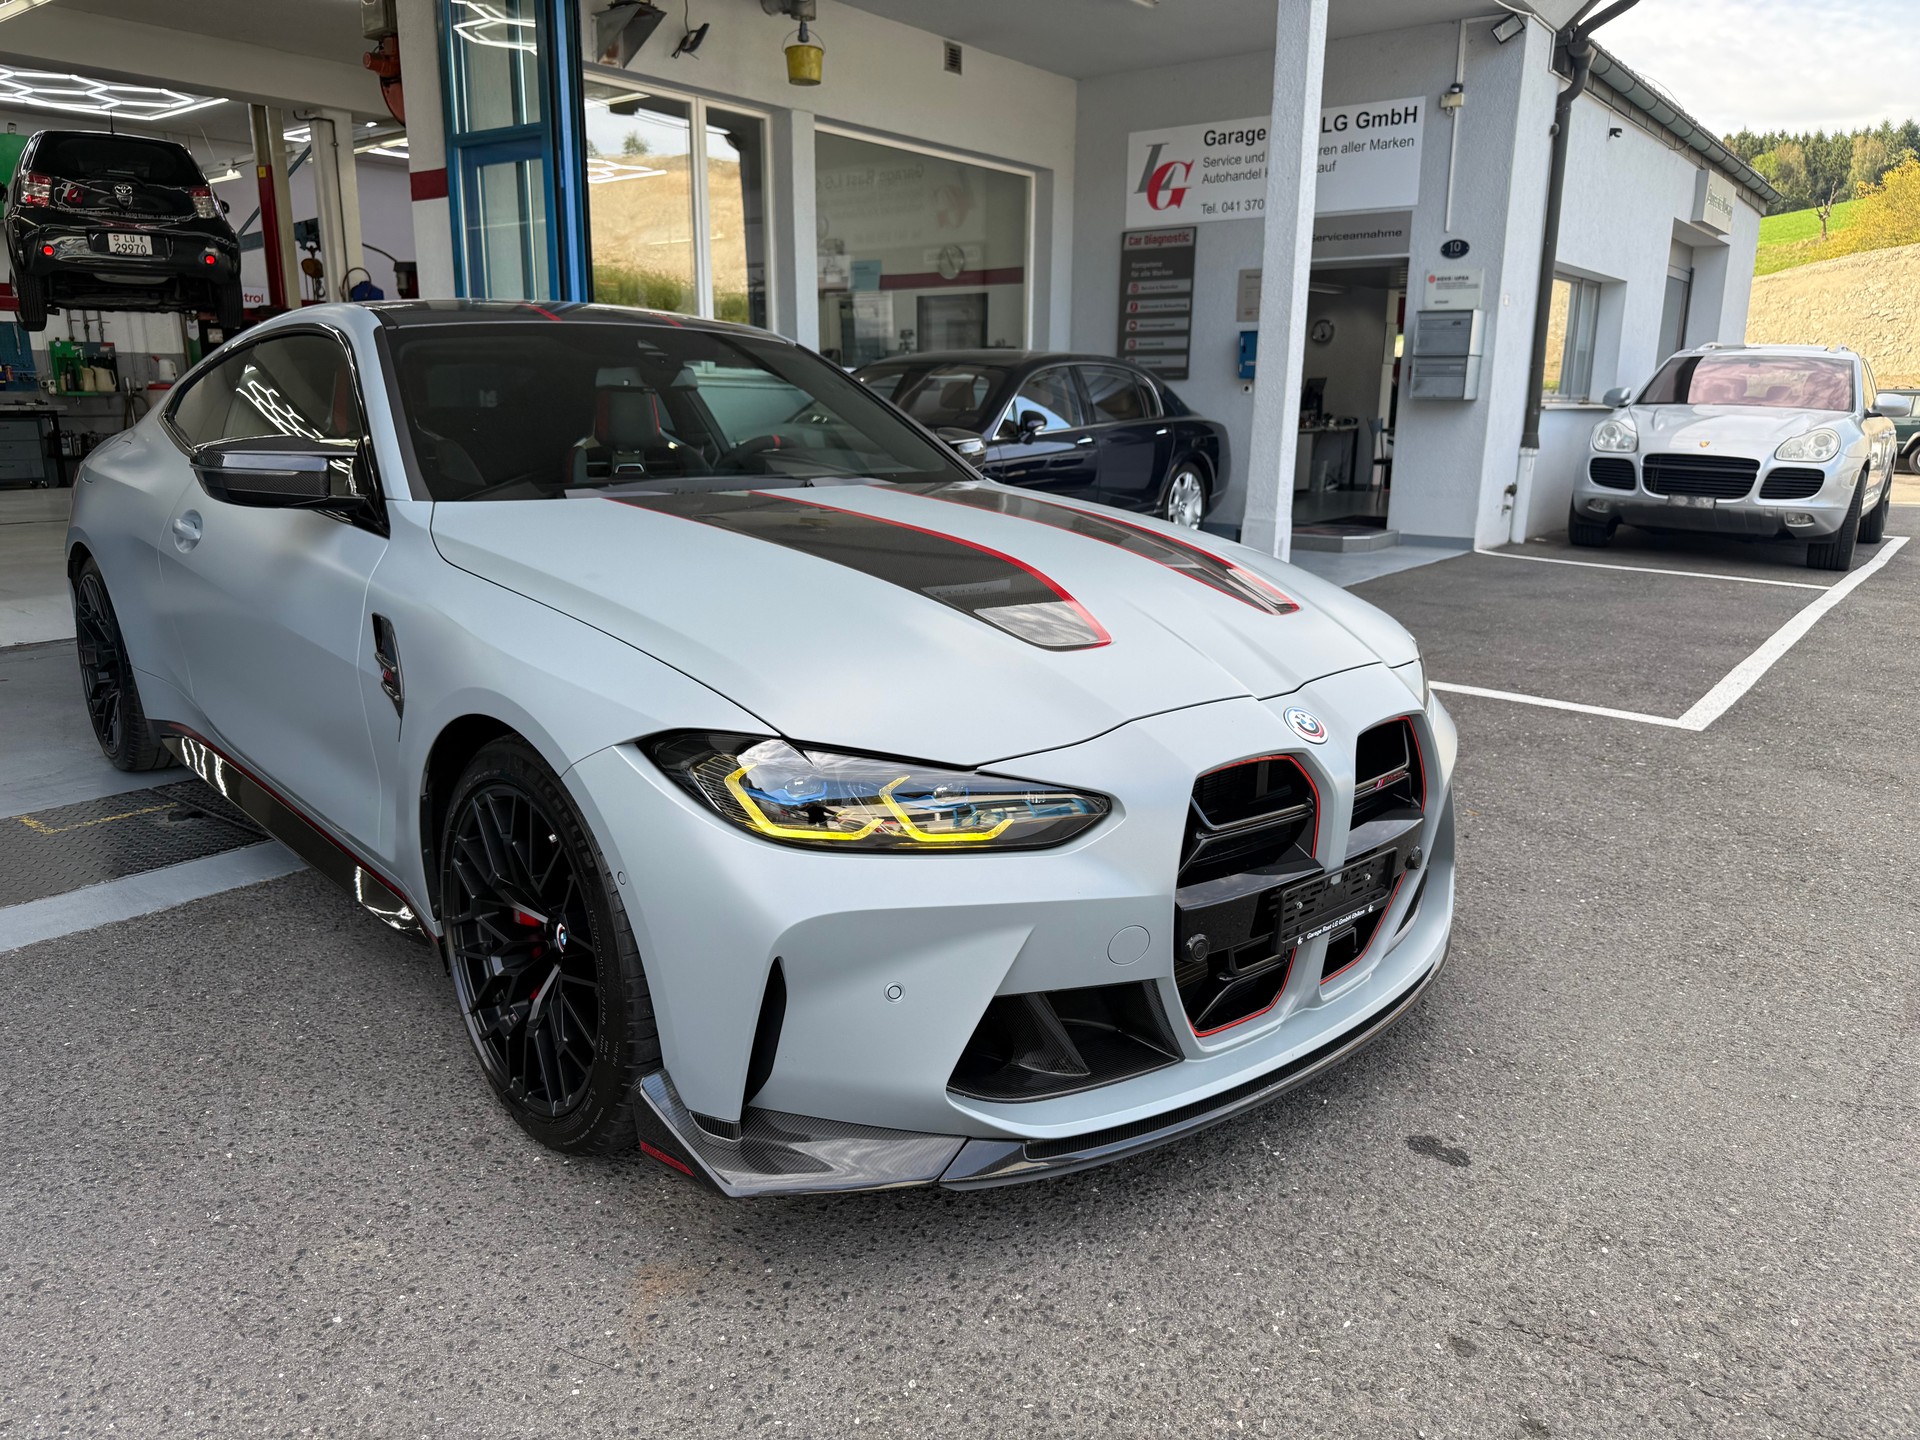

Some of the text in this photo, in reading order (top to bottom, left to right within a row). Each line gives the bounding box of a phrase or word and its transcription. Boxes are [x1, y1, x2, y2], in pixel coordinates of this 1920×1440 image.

[1203, 105, 1418, 147] Garage LG GmbH
[1202, 137, 1415, 169] Service und ren aller Marken
[1201, 168, 1262, 185] Autohandel
[1200, 198, 1265, 215] Tel. 041 370
[124, 234, 136, 244] LU
[1128, 232, 1191, 246] Car Diagnostic
[1449, 241, 1462, 252] 10
[243, 292, 265, 304] trol
